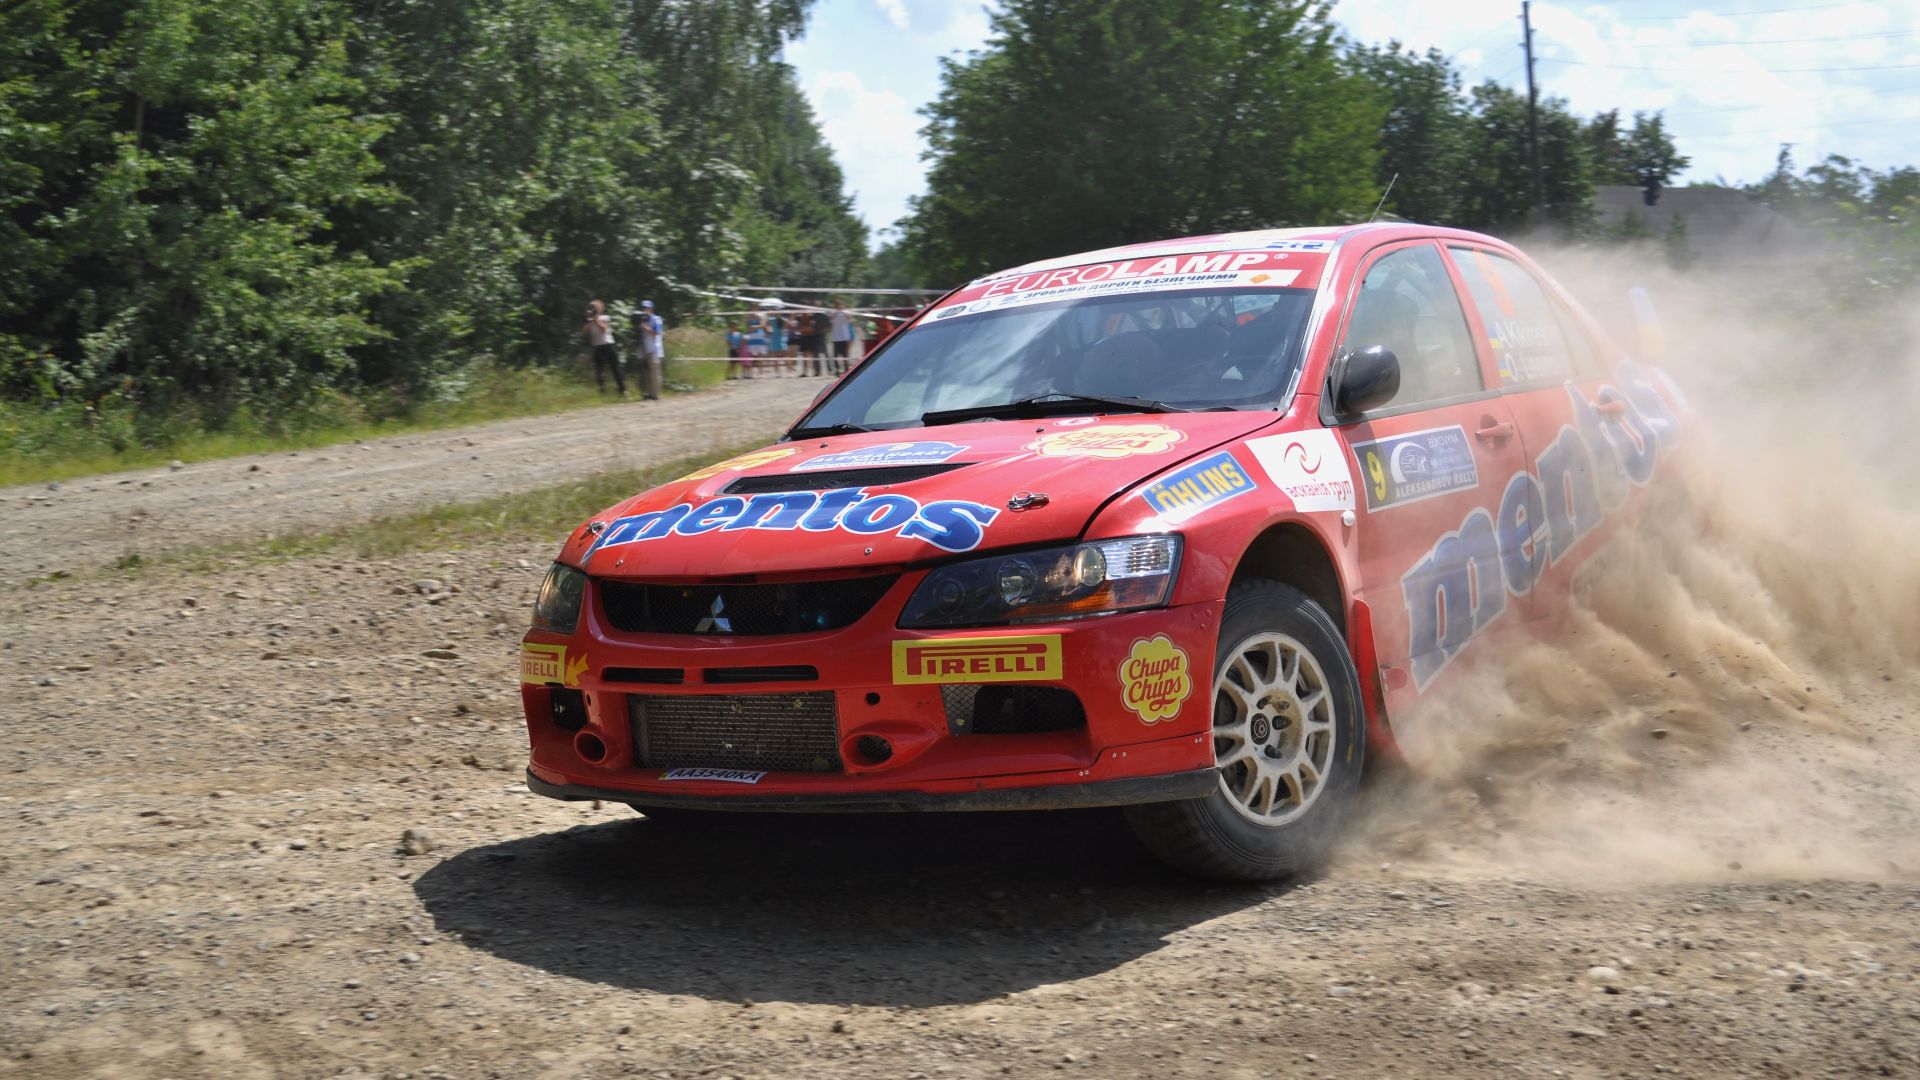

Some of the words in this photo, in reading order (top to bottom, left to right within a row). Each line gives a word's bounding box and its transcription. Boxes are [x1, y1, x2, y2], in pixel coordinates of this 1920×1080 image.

[981, 252, 1269, 298] EUROLAMP
[1088, 279, 1141, 291] ДОРОГИ
[1143, 273, 1239, 285] БЕЗПЕЧНИМИ
[1366, 451, 1387, 501] 9
[1396, 477, 1453, 499] ALEKSANDROV
[1454, 469, 1476, 486] RALLY
[580, 486, 1002, 564] mentos
[906, 643, 1047, 676] PIRELLI
[1128, 655, 1180, 680] Chupa
[1128, 676, 1182, 711] Chups
